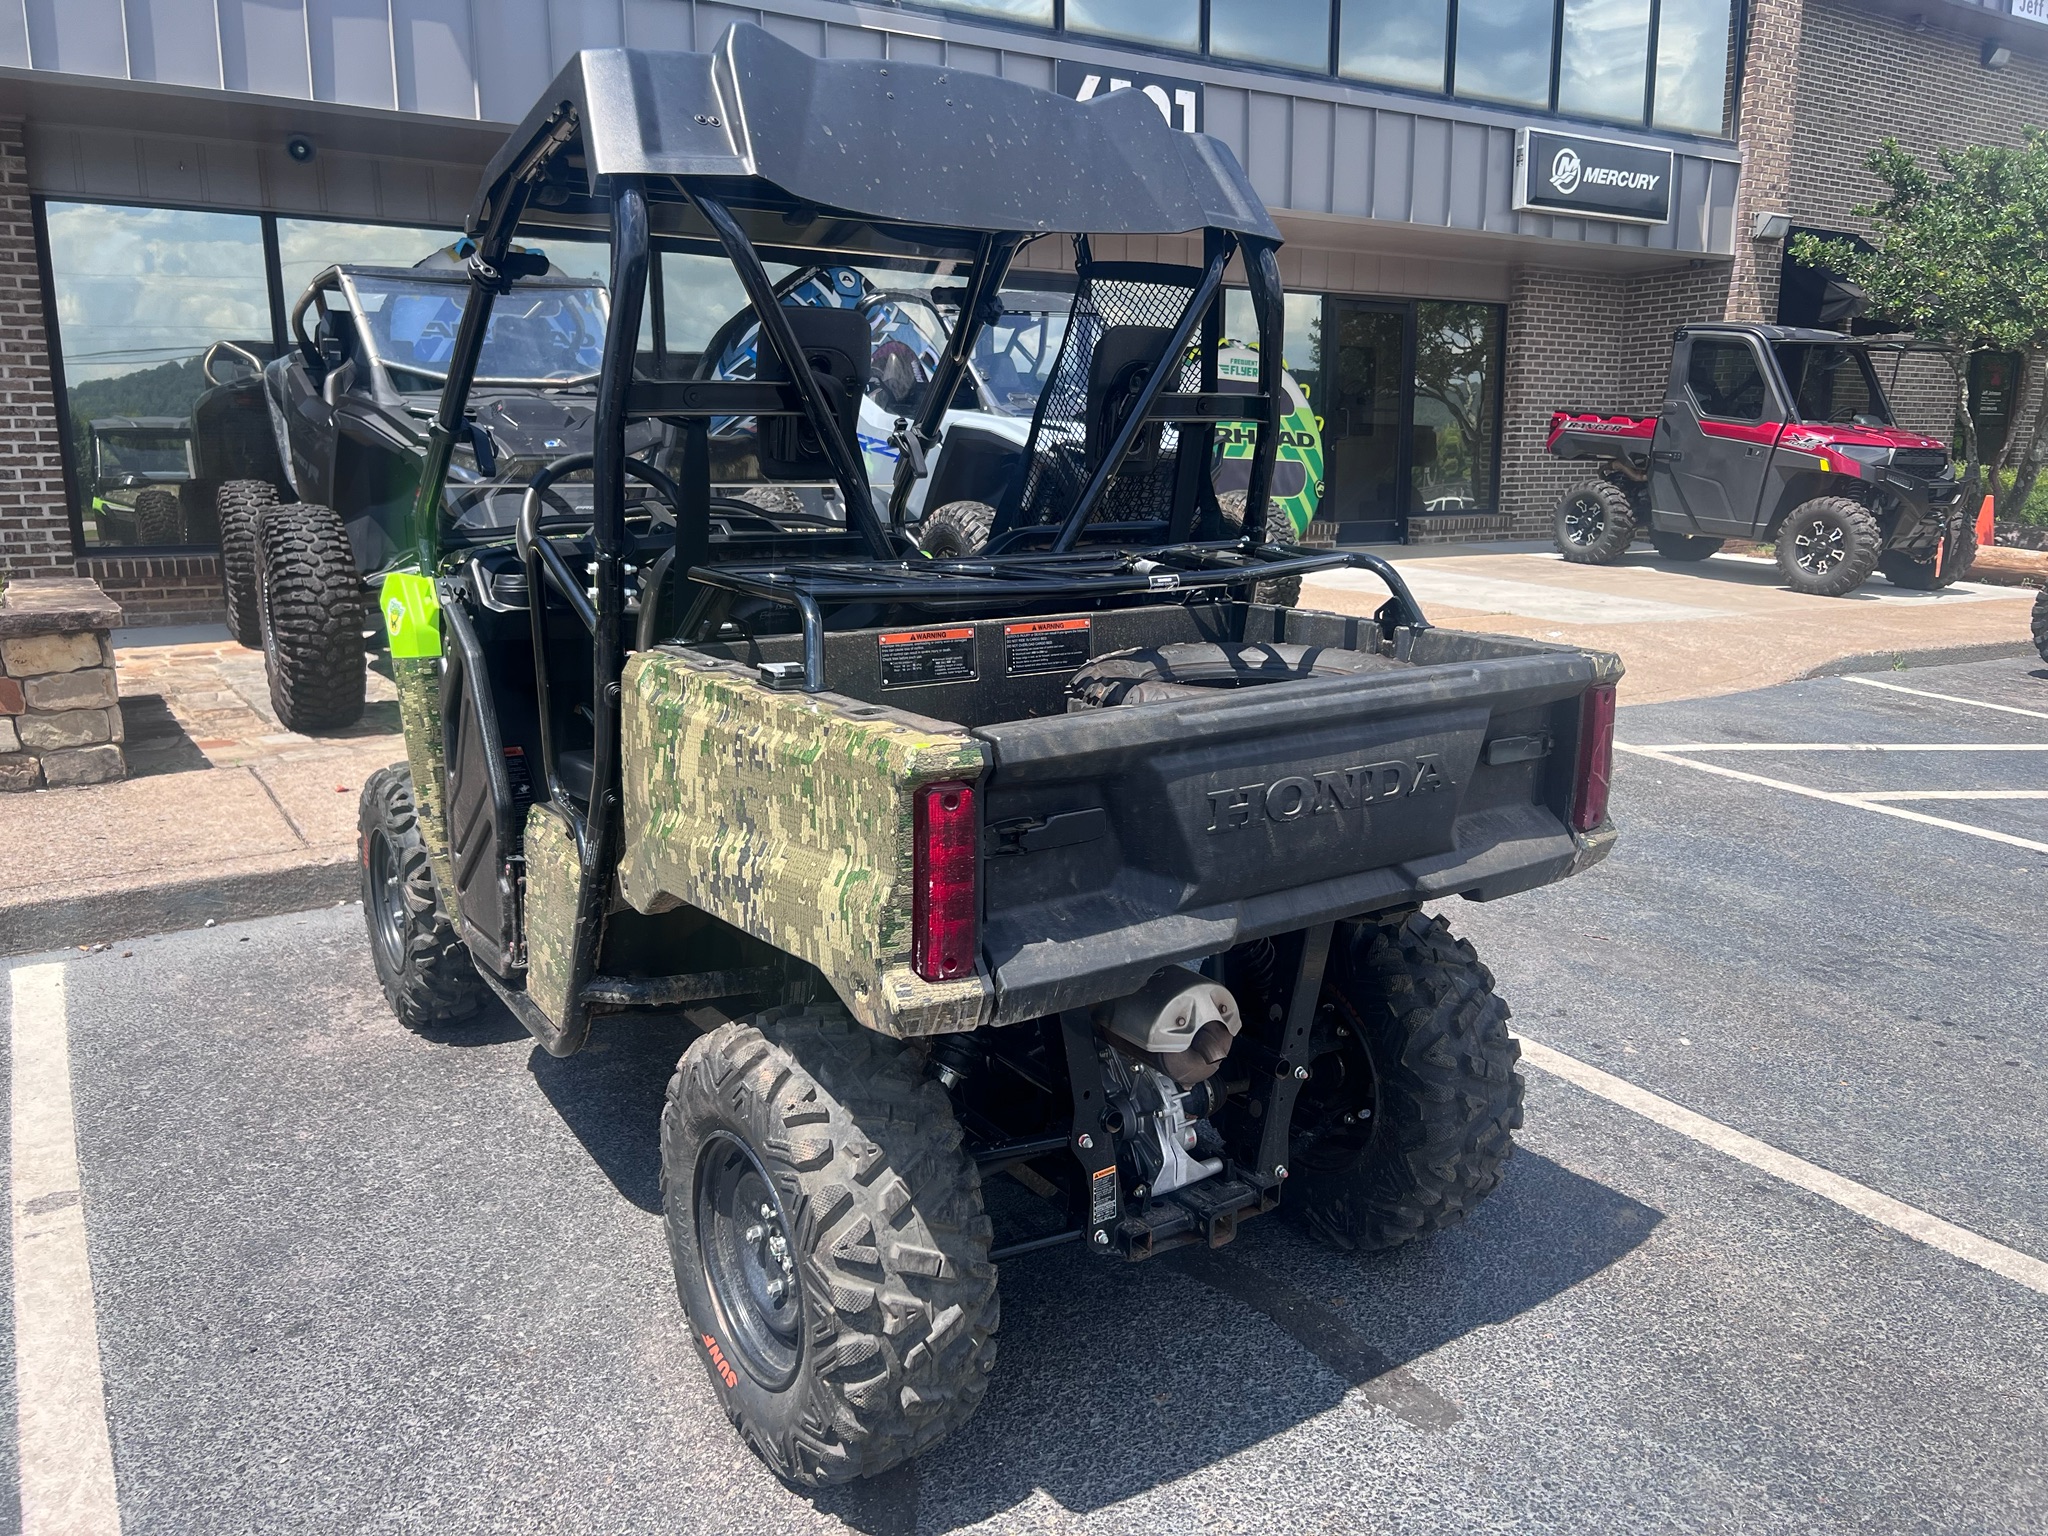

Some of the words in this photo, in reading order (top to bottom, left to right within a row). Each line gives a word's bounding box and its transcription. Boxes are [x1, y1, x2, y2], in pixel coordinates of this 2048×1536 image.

[1582, 167, 1660, 190] MERCURY
[1230, 358, 1258, 367] FREQUENT
[1230, 366, 1259, 378] FLYER
[1567, 421, 1623, 432] RANGER
[1038, 623, 1065, 631] WARNING
[916, 631, 947, 640] WARNING
[1206, 753, 1455, 835] HONDA
